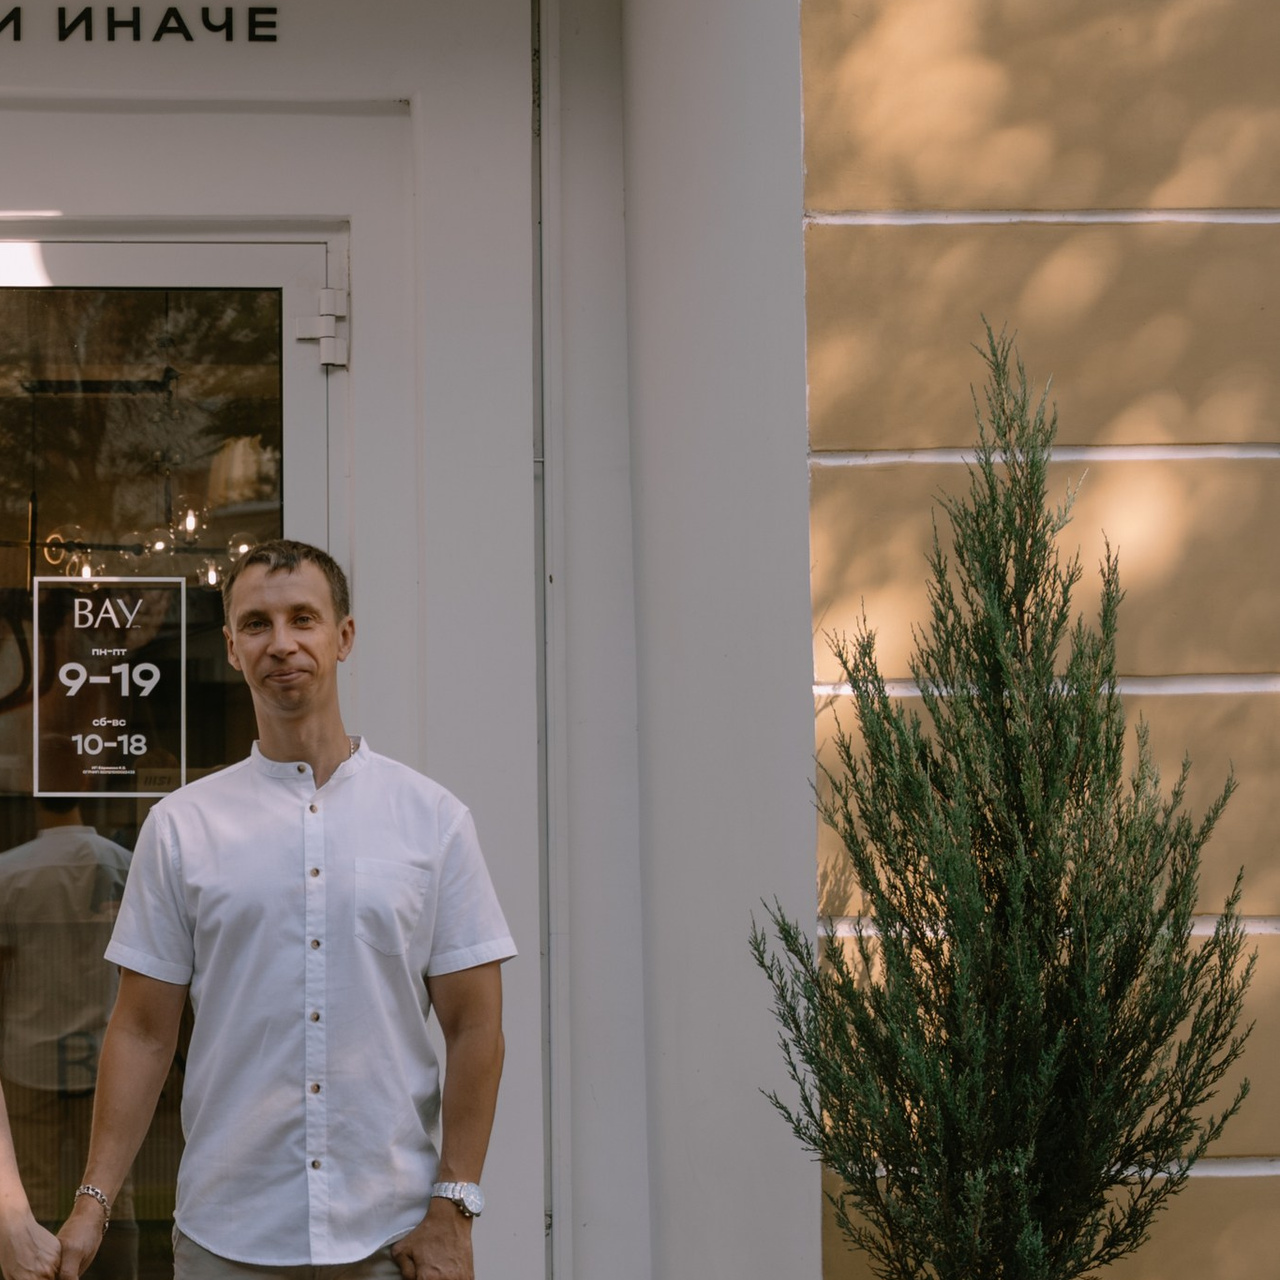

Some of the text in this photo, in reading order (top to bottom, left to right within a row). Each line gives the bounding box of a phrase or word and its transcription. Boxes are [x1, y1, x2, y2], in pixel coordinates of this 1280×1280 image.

[57, 6, 279, 43] ИНАЧЕ
[58, 662, 161, 697] 9-19
[71, 733, 148, 756] 10-18
